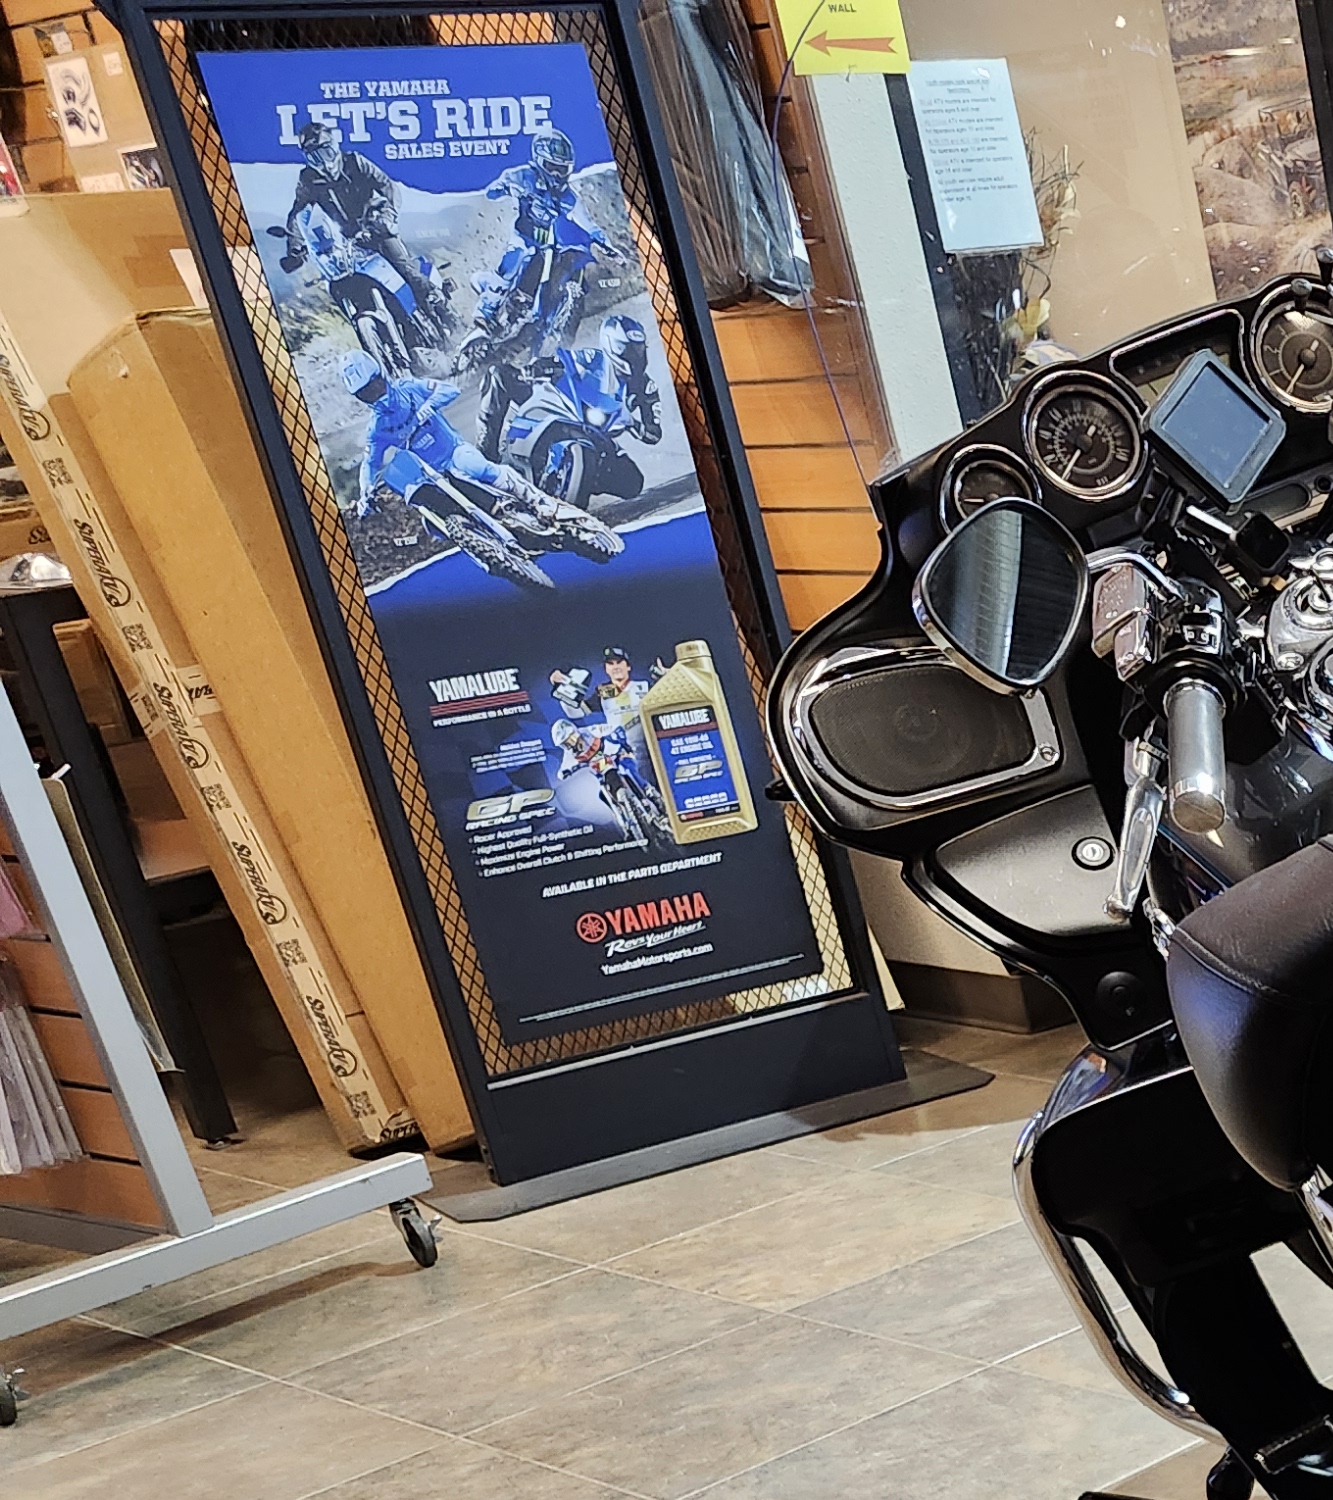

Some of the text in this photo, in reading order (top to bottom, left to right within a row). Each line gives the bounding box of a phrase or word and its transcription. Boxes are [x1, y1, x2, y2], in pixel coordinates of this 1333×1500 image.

[828, 4, 857, 13] WALL
[320, 79, 450, 99] THE YAMAHA
[276, 96, 553, 146] LET'S RIDE
[385, 139, 510, 160] SALES EVENT
[429, 668, 521, 702] YAMALUBE
[658, 708, 710, 730] YAMALUBE
[467, 788, 555, 821] GP
[465, 806, 556, 831] RACING SPEC
[474, 826, 532, 843] Racer Approved
[542, 843, 565, 853] Power
[543, 854, 566, 865] Clutch
[542, 852, 723, 898] AVAILABLE IN THE PARTS DEPARTMENT
[604, 891, 712, 936] YAMAHA
[604, 934, 645, 957] Revs
[645, 928, 673, 948] Your
[601, 943, 714, 976] YamahaMotorsports.com
